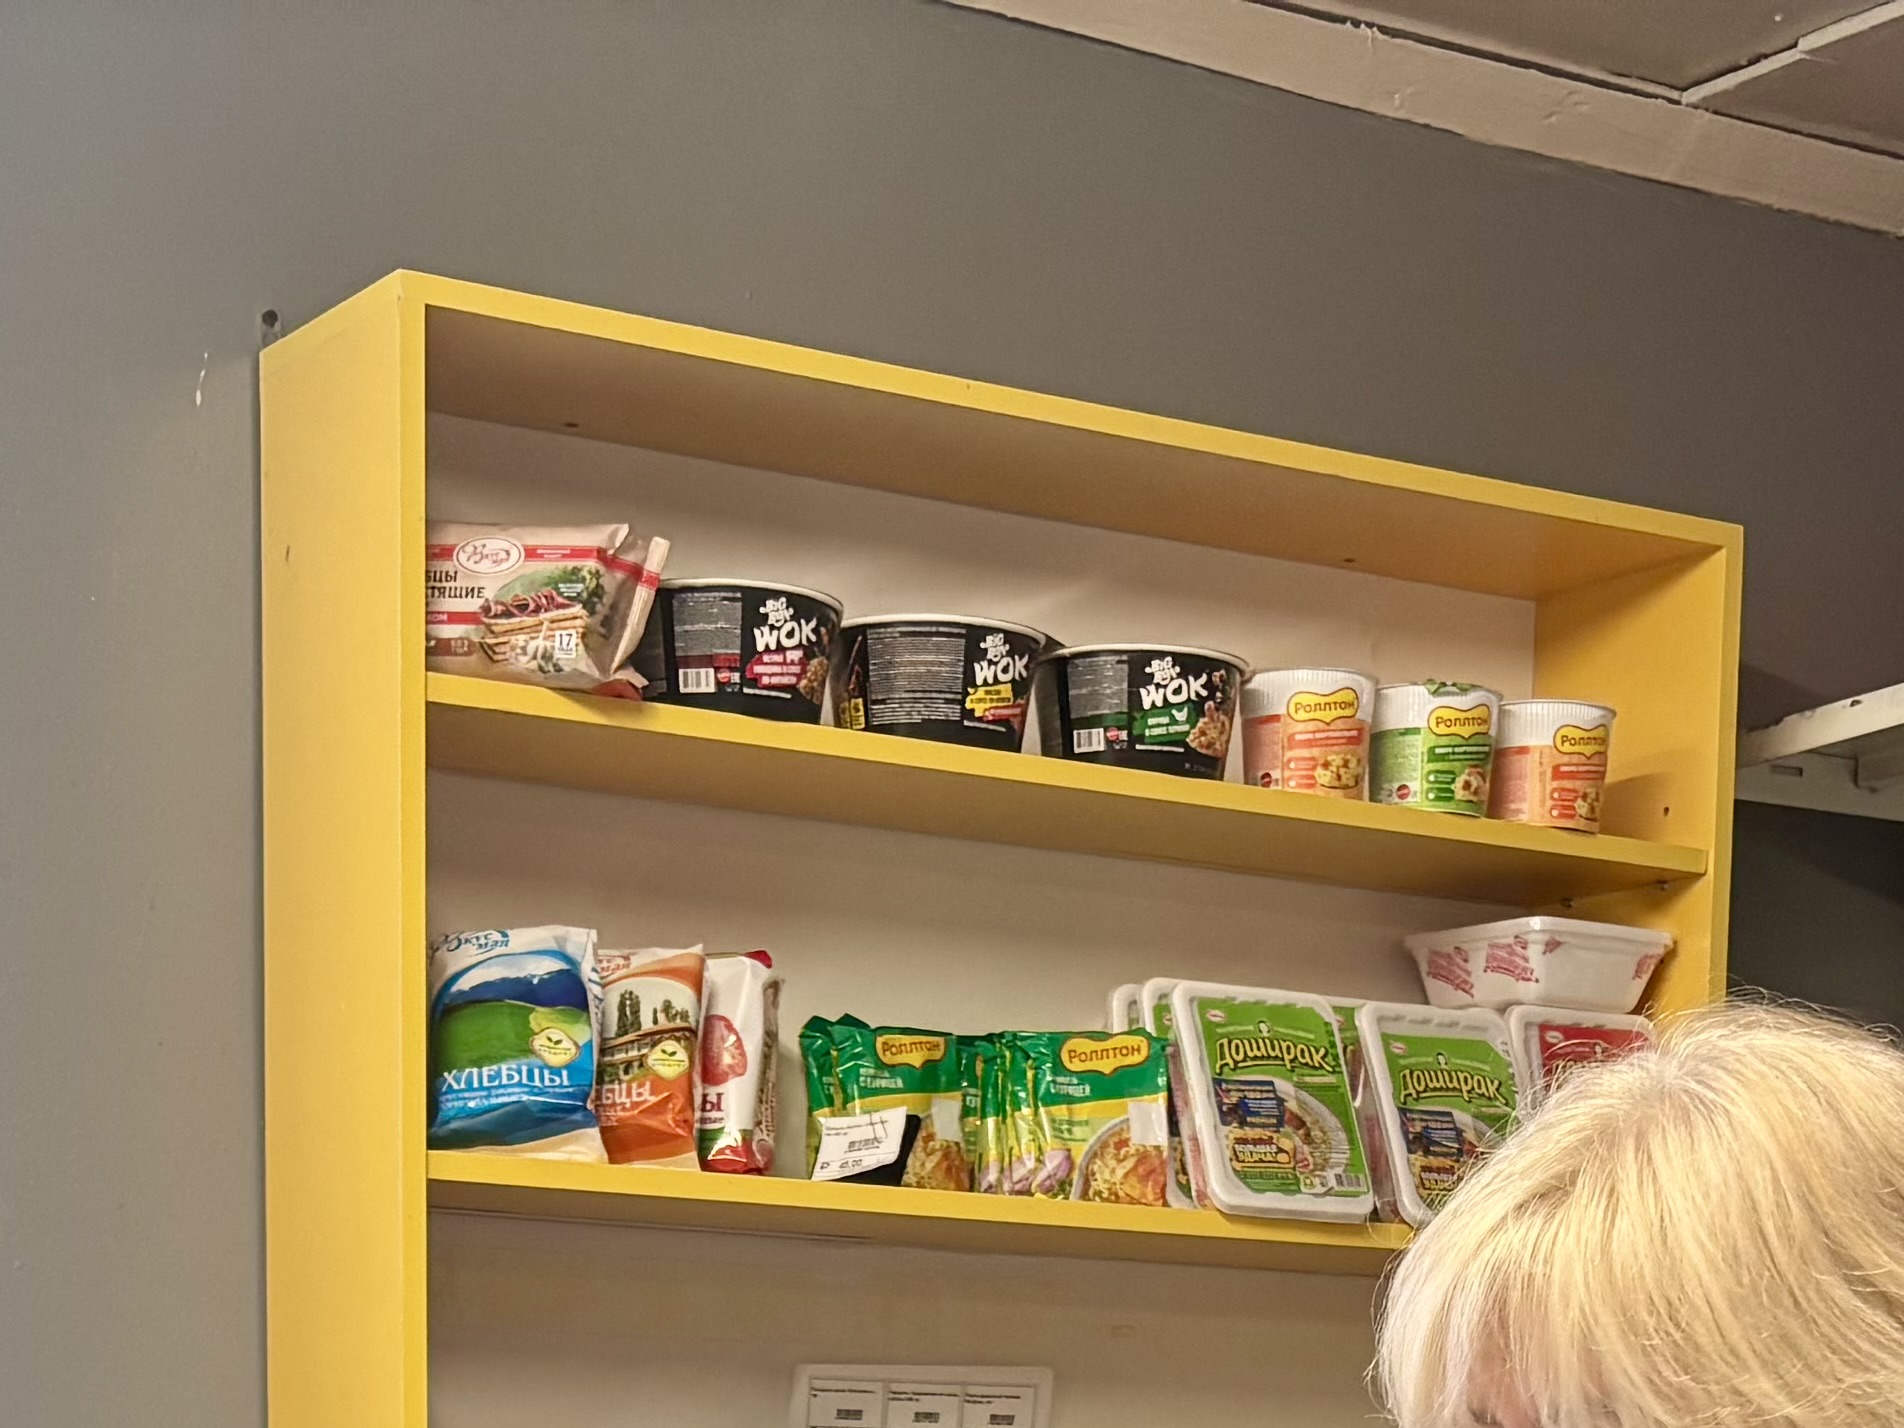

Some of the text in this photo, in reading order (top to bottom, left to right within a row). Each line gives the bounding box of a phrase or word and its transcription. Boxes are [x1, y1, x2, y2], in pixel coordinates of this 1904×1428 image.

[754, 619, 818, 652] WOK
[973, 654, 1030, 685] WOK
[1140, 674, 1208, 709] WOK
[1216, 1038, 1335, 1075] Доширак
[442, 1064, 570, 1092] ХЛЕБЦЫ
[1399, 1067, 1506, 1104] Доширак
